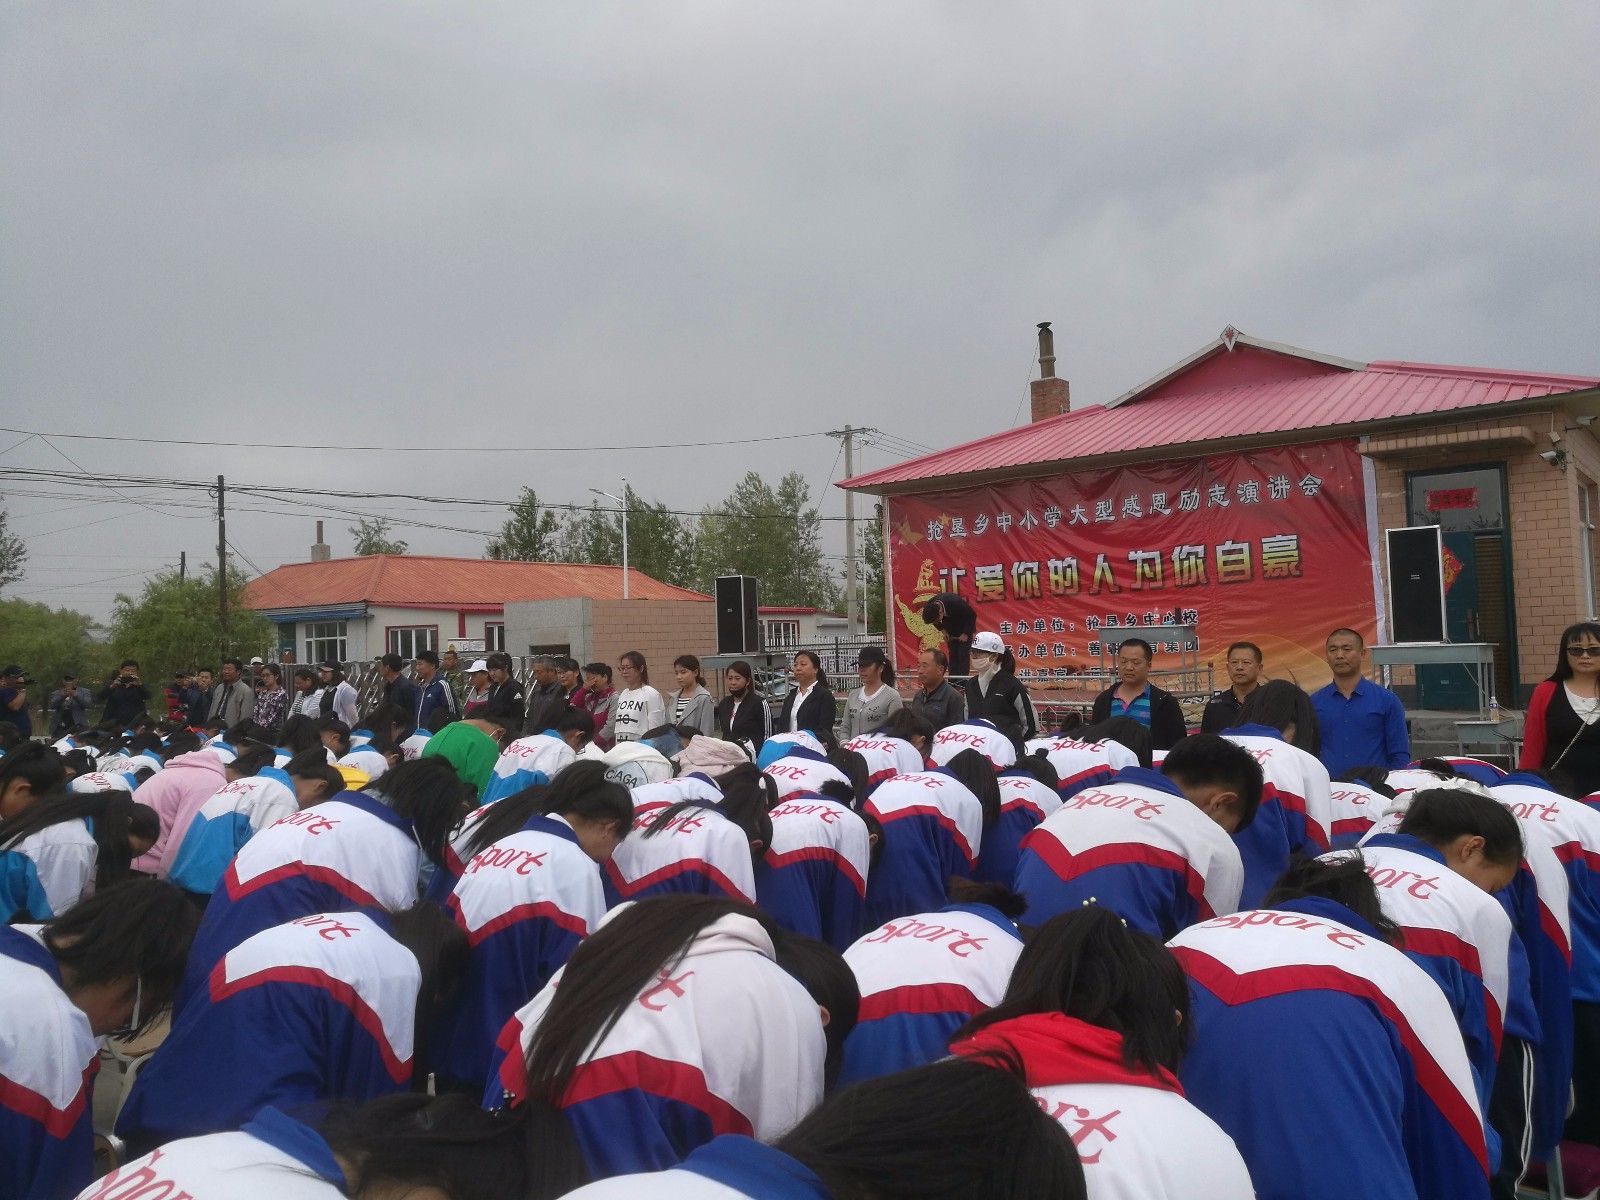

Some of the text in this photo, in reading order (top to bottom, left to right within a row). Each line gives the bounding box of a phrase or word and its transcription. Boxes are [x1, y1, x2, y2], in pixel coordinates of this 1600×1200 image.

[926, 472, 1323, 541] 抢垦乡中小学大型感恩励志演讲会
[939, 533, 1304, 603] 让爱你的人为你自豪
[618, 701, 644, 712] ORN
